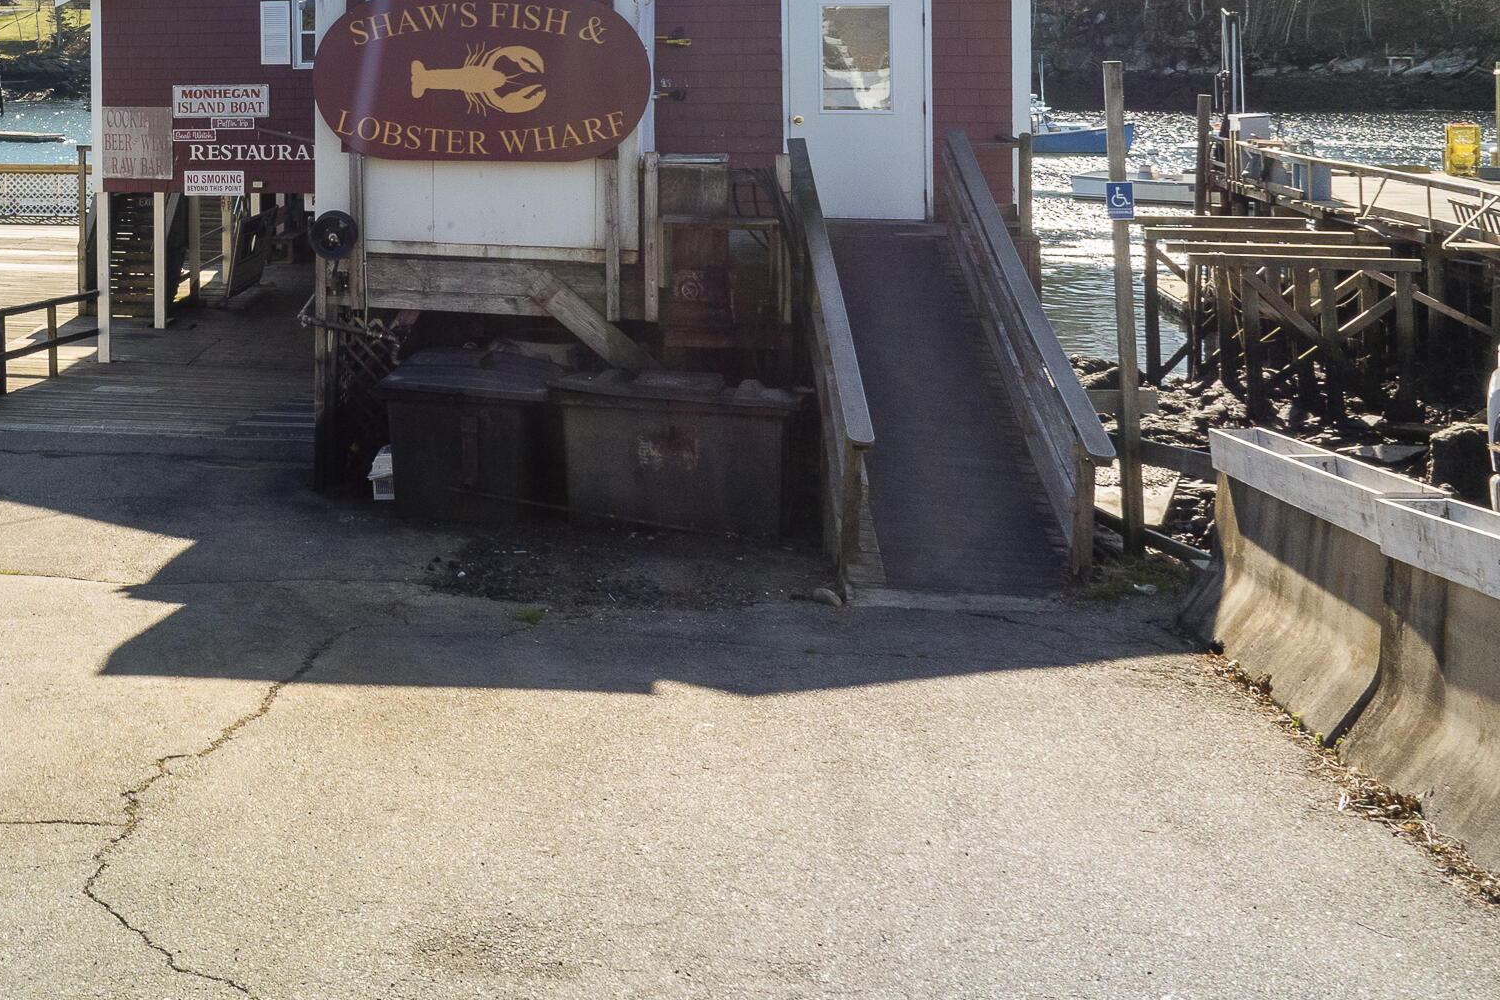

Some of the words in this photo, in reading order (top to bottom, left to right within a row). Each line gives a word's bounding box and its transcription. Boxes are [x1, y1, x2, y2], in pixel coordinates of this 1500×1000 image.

[349, 2, 478, 46] SHAW'S
[488, 2, 572, 35] FISH
[579, 16, 608, 44] &
[181, 88, 260, 99] MONHEGAN
[177, 102, 225, 113] ISLAND
[230, 101, 265, 113] BOAT
[217, 119, 237, 128] Puffin
[237, 119, 249, 128] Trip
[175, 131, 191, 139] Seal
[335, 109, 491, 155] LOBSTER
[497, 111, 624, 153] WHARF
[104, 133, 132, 151] BEER
[189, 144, 315, 160] RESTAURA
[111, 156, 137, 175] RAW
[140, 157, 164, 176] BAR
[187, 174, 199, 184] NO
[201, 174, 242, 184] SMOKING
